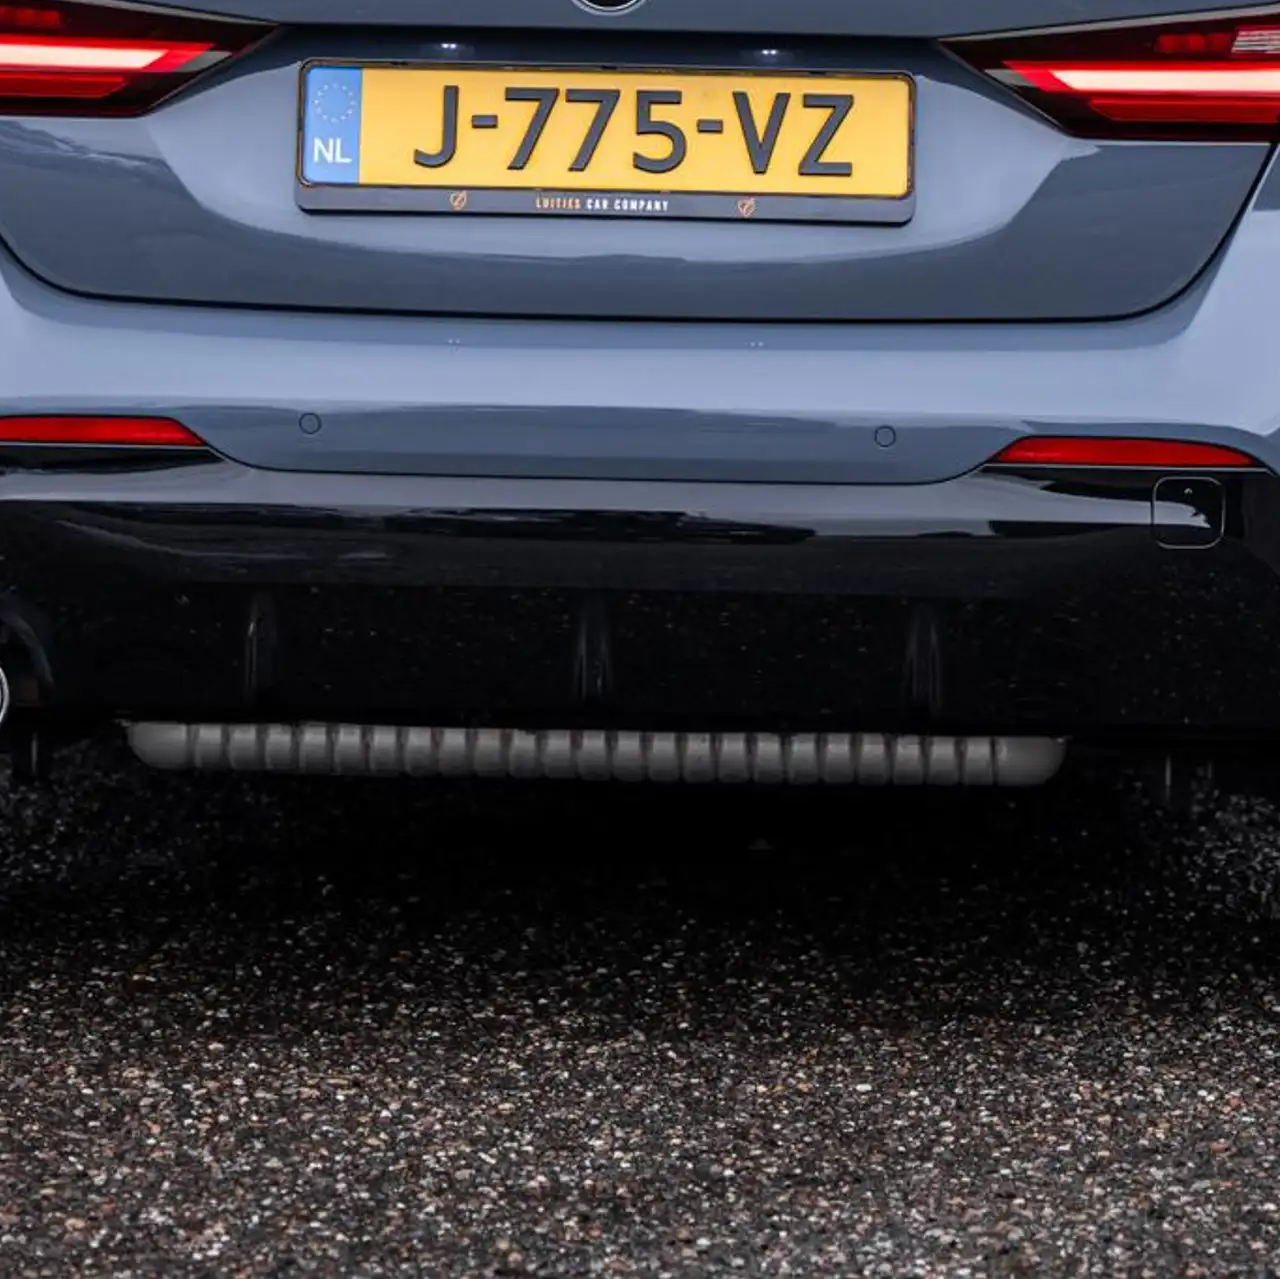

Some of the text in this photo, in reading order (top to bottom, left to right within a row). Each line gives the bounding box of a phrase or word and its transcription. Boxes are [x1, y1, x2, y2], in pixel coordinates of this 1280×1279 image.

[312, 84, 856, 176] NL J-775-VZ
[586, 197, 609, 211] CAR
[613, 198, 669, 213] COMPANY
